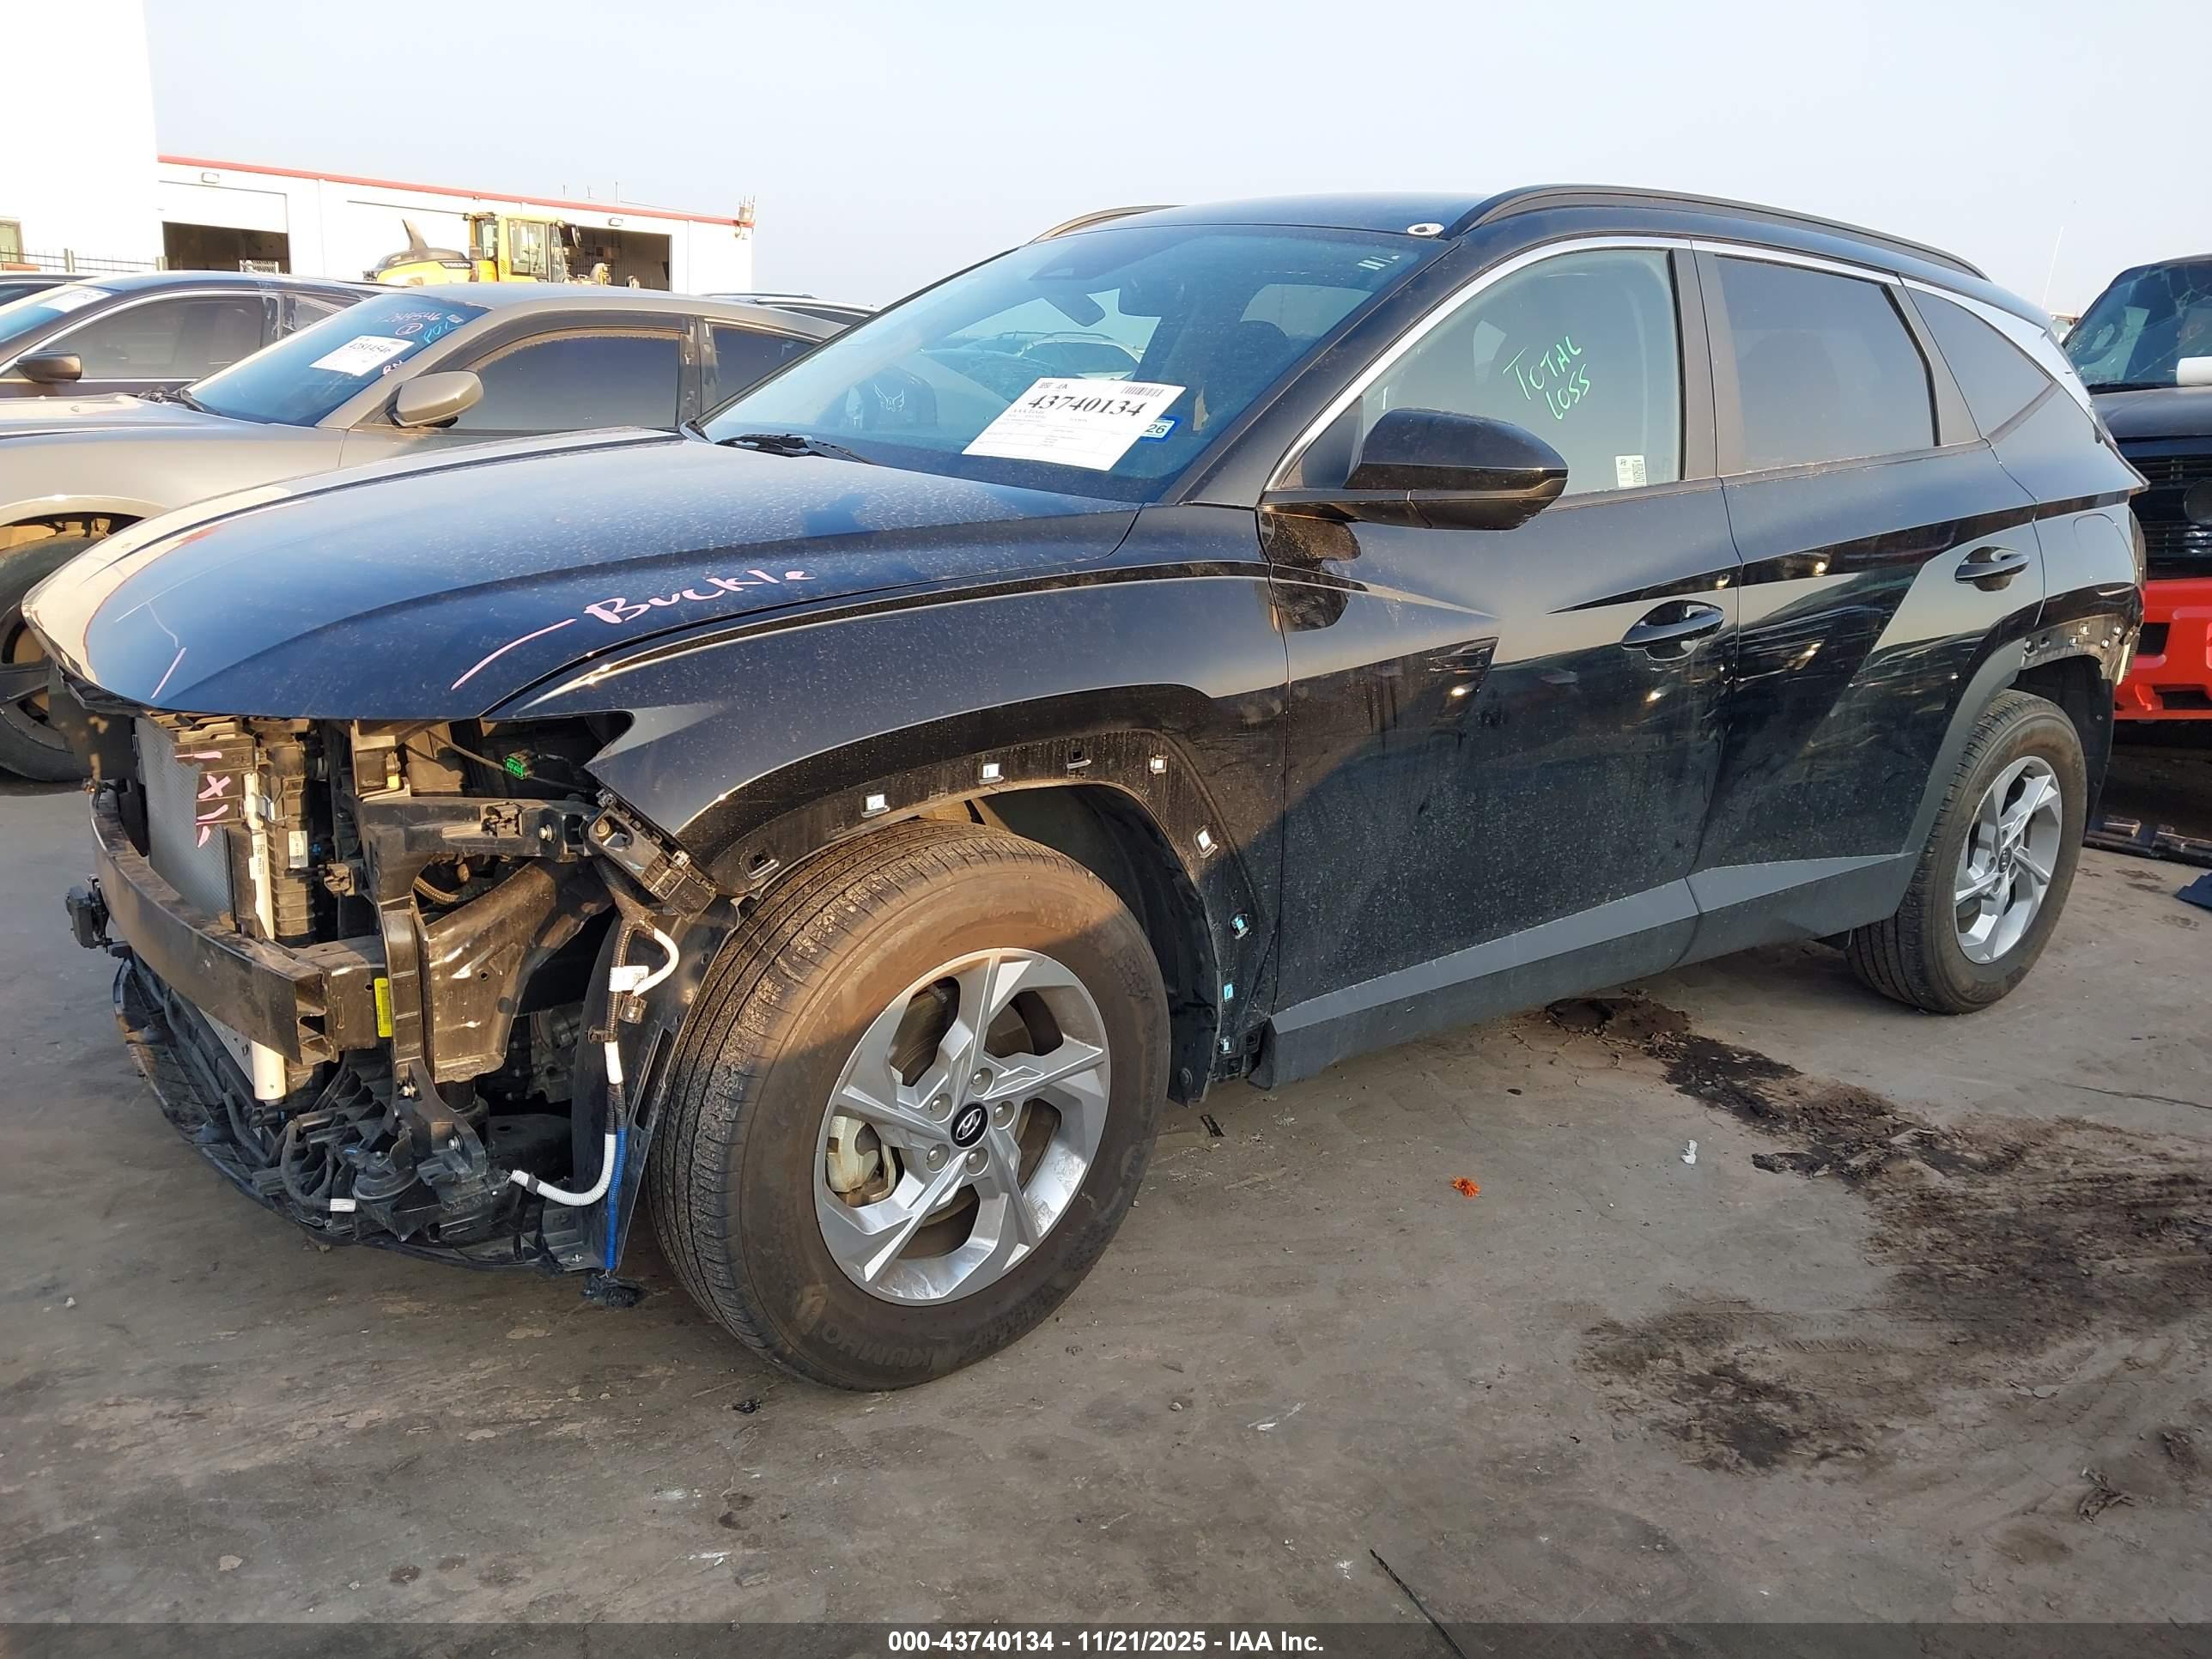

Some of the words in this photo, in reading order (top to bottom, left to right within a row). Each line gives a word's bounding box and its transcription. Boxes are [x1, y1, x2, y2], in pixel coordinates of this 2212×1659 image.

[1501, 336, 1583, 401] TOTAL
[1028, 394, 1147, 417] 43740134
[1546, 363, 1591, 420] LOSS
[1146, 422, 1166, 434] 26
